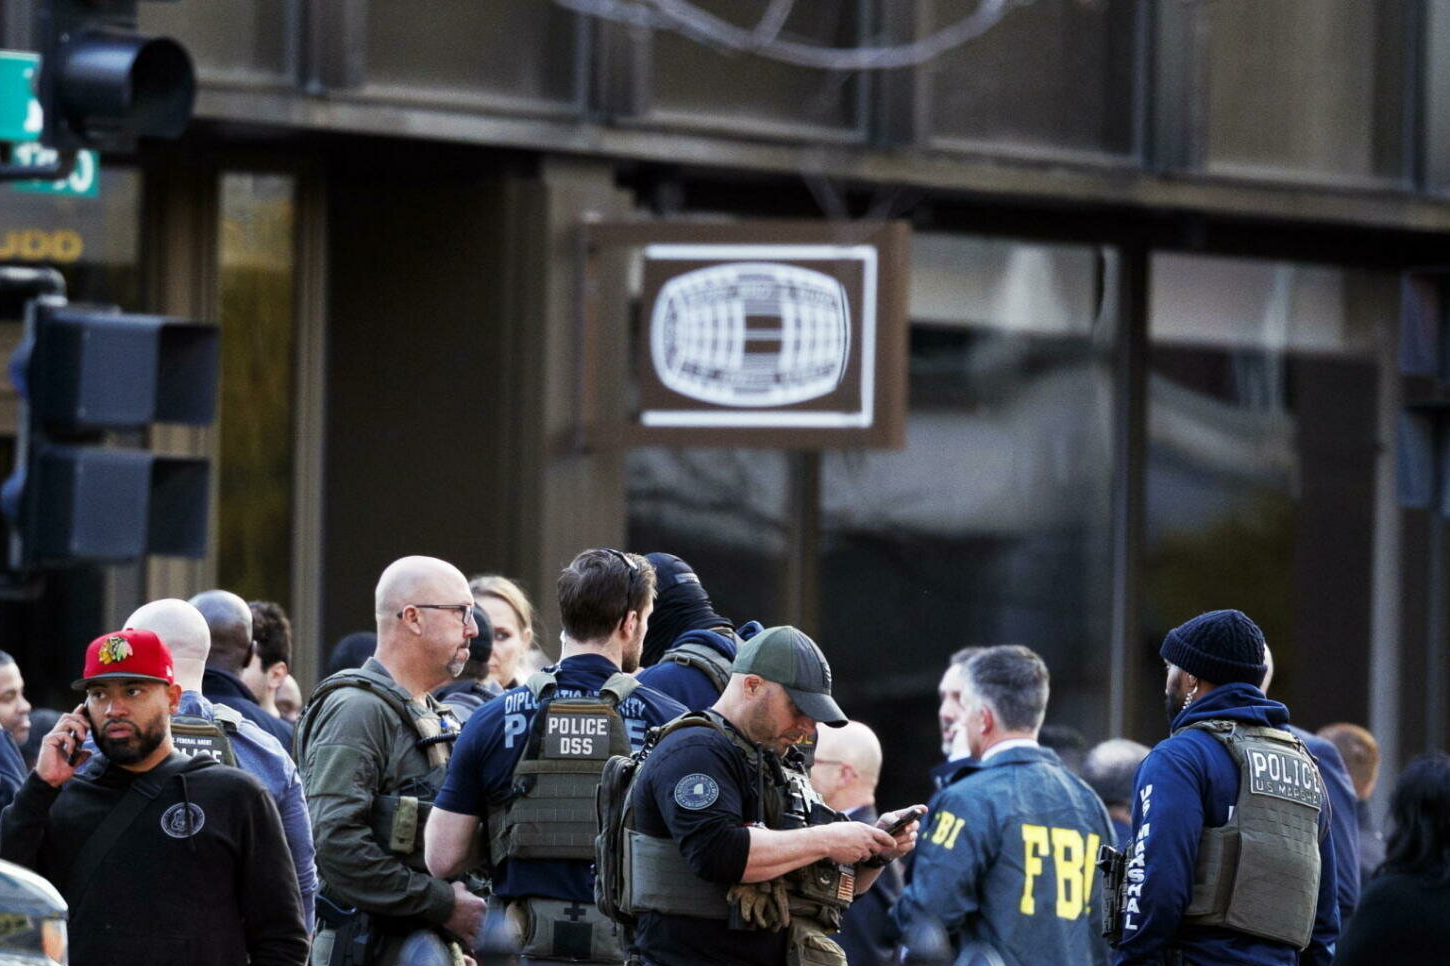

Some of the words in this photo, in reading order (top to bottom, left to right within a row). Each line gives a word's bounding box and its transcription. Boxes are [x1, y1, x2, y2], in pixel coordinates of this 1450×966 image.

[548, 717, 608, 736] POLICE
[560, 737, 593, 755] DSS
[1019, 823, 1101, 921] FBI
[1124, 822, 1151, 931] MARSHAL
